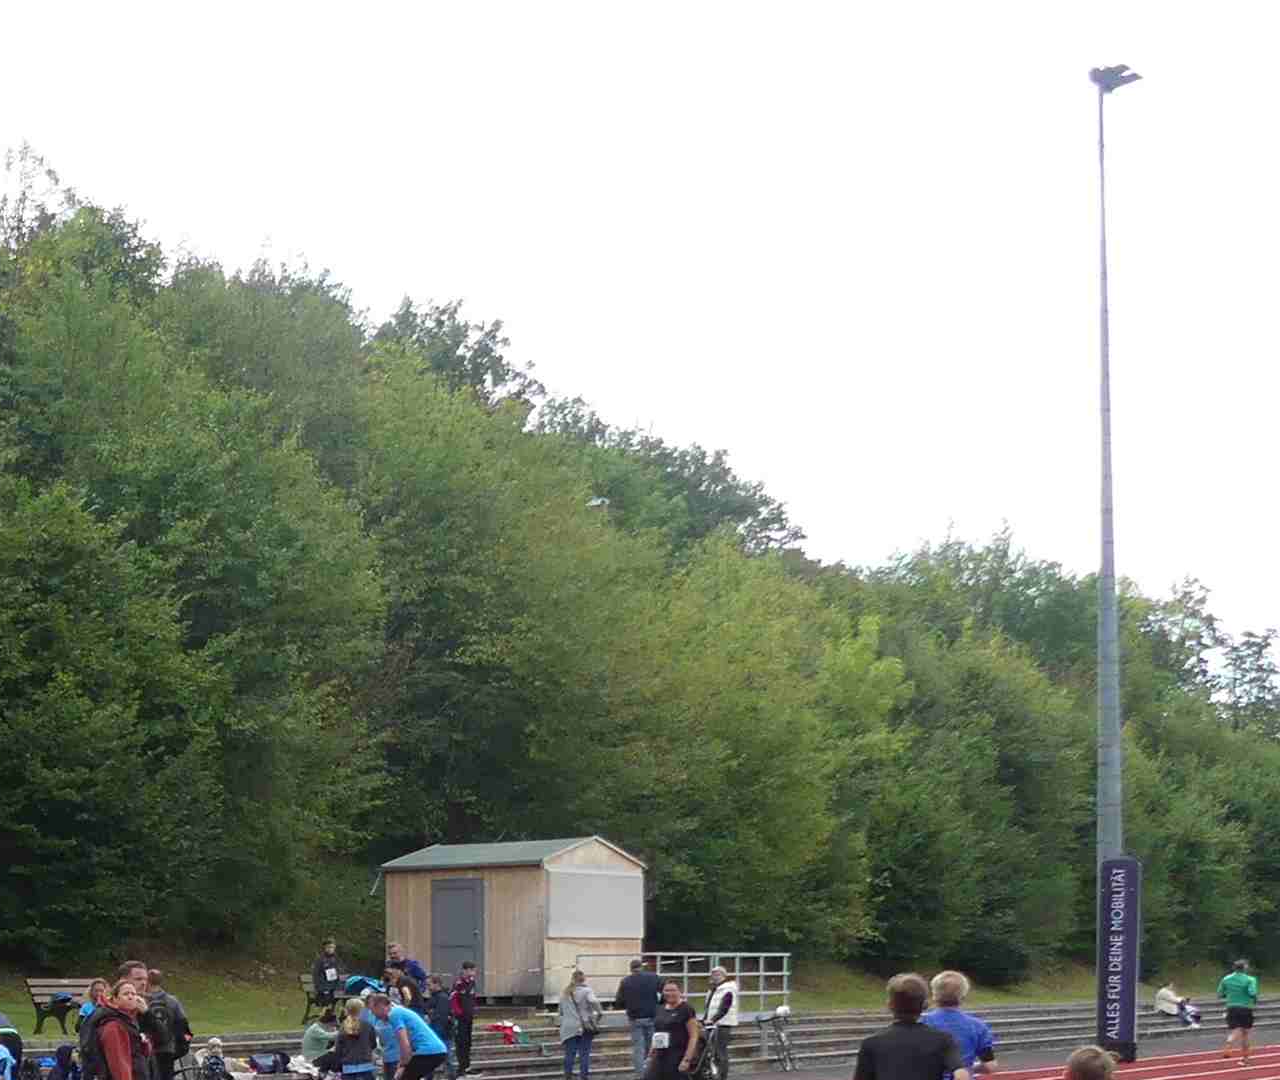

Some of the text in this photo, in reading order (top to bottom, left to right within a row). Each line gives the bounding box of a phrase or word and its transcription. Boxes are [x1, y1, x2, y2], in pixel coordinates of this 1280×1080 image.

[1106, 868, 1126, 1039] ALLES FÜR DEINE MOBILITÄT
